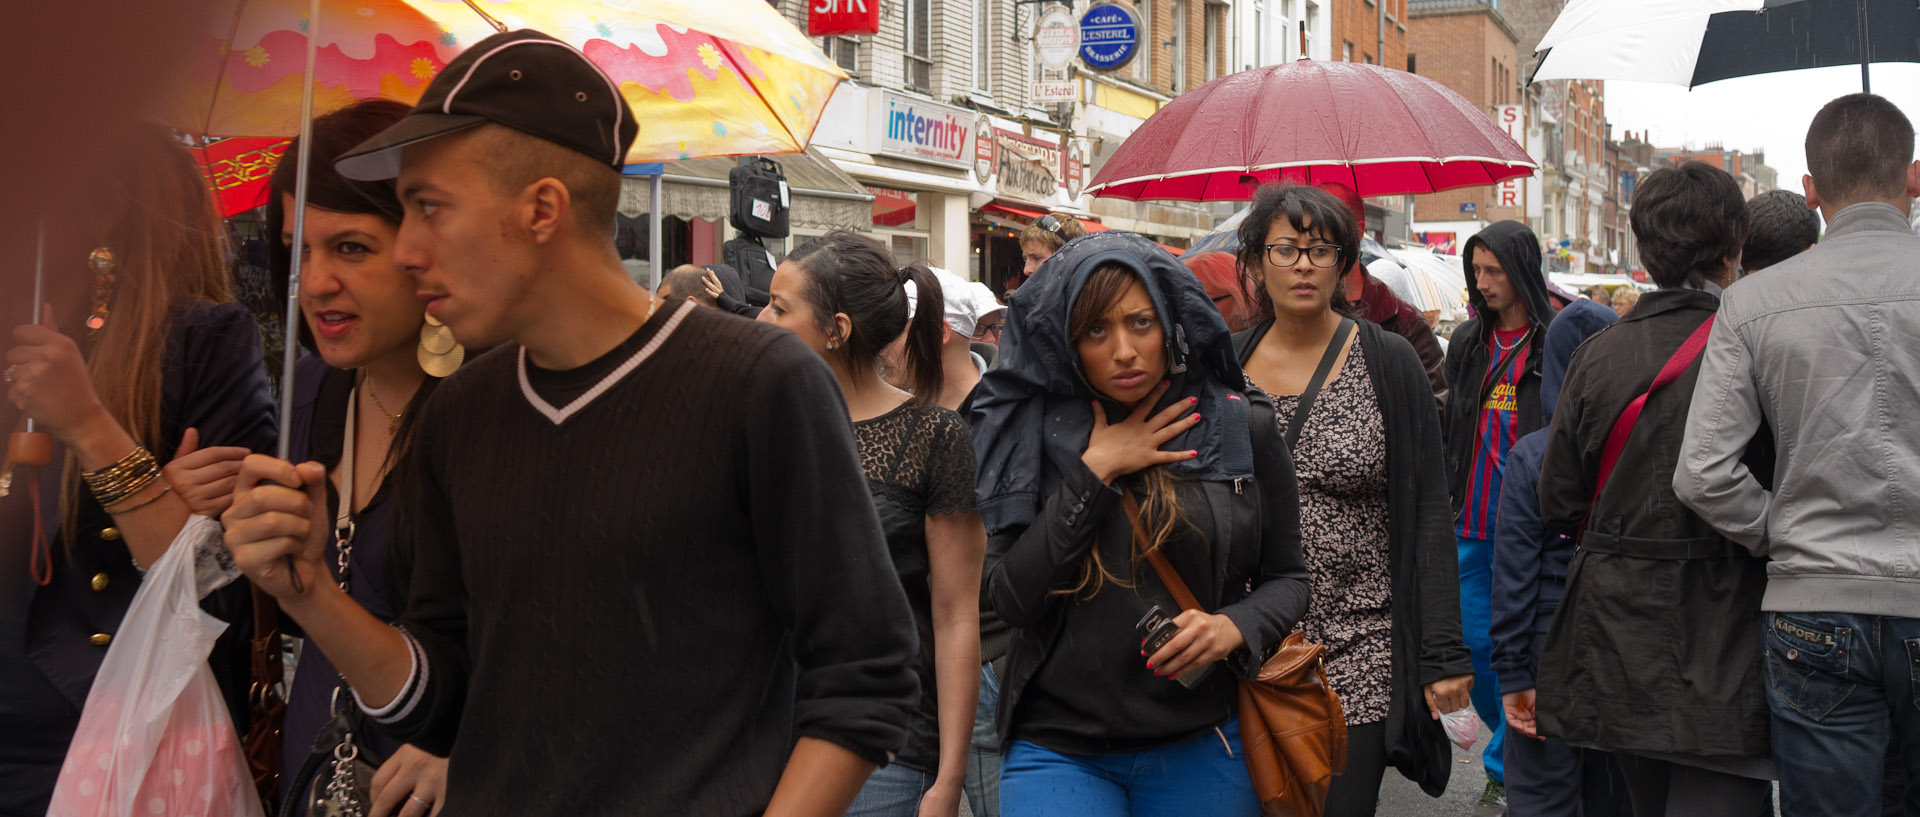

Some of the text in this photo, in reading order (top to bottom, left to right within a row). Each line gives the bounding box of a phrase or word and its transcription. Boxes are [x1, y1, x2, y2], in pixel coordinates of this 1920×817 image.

[1094, 15, 1118, 24] CAFÉ
[1082, 28, 1130, 41] L'ESTEREL
[1084, 44, 1128, 62] BRASSERIE
[888, 97, 967, 160] internity
[1503, 106, 1518, 206] SIER
